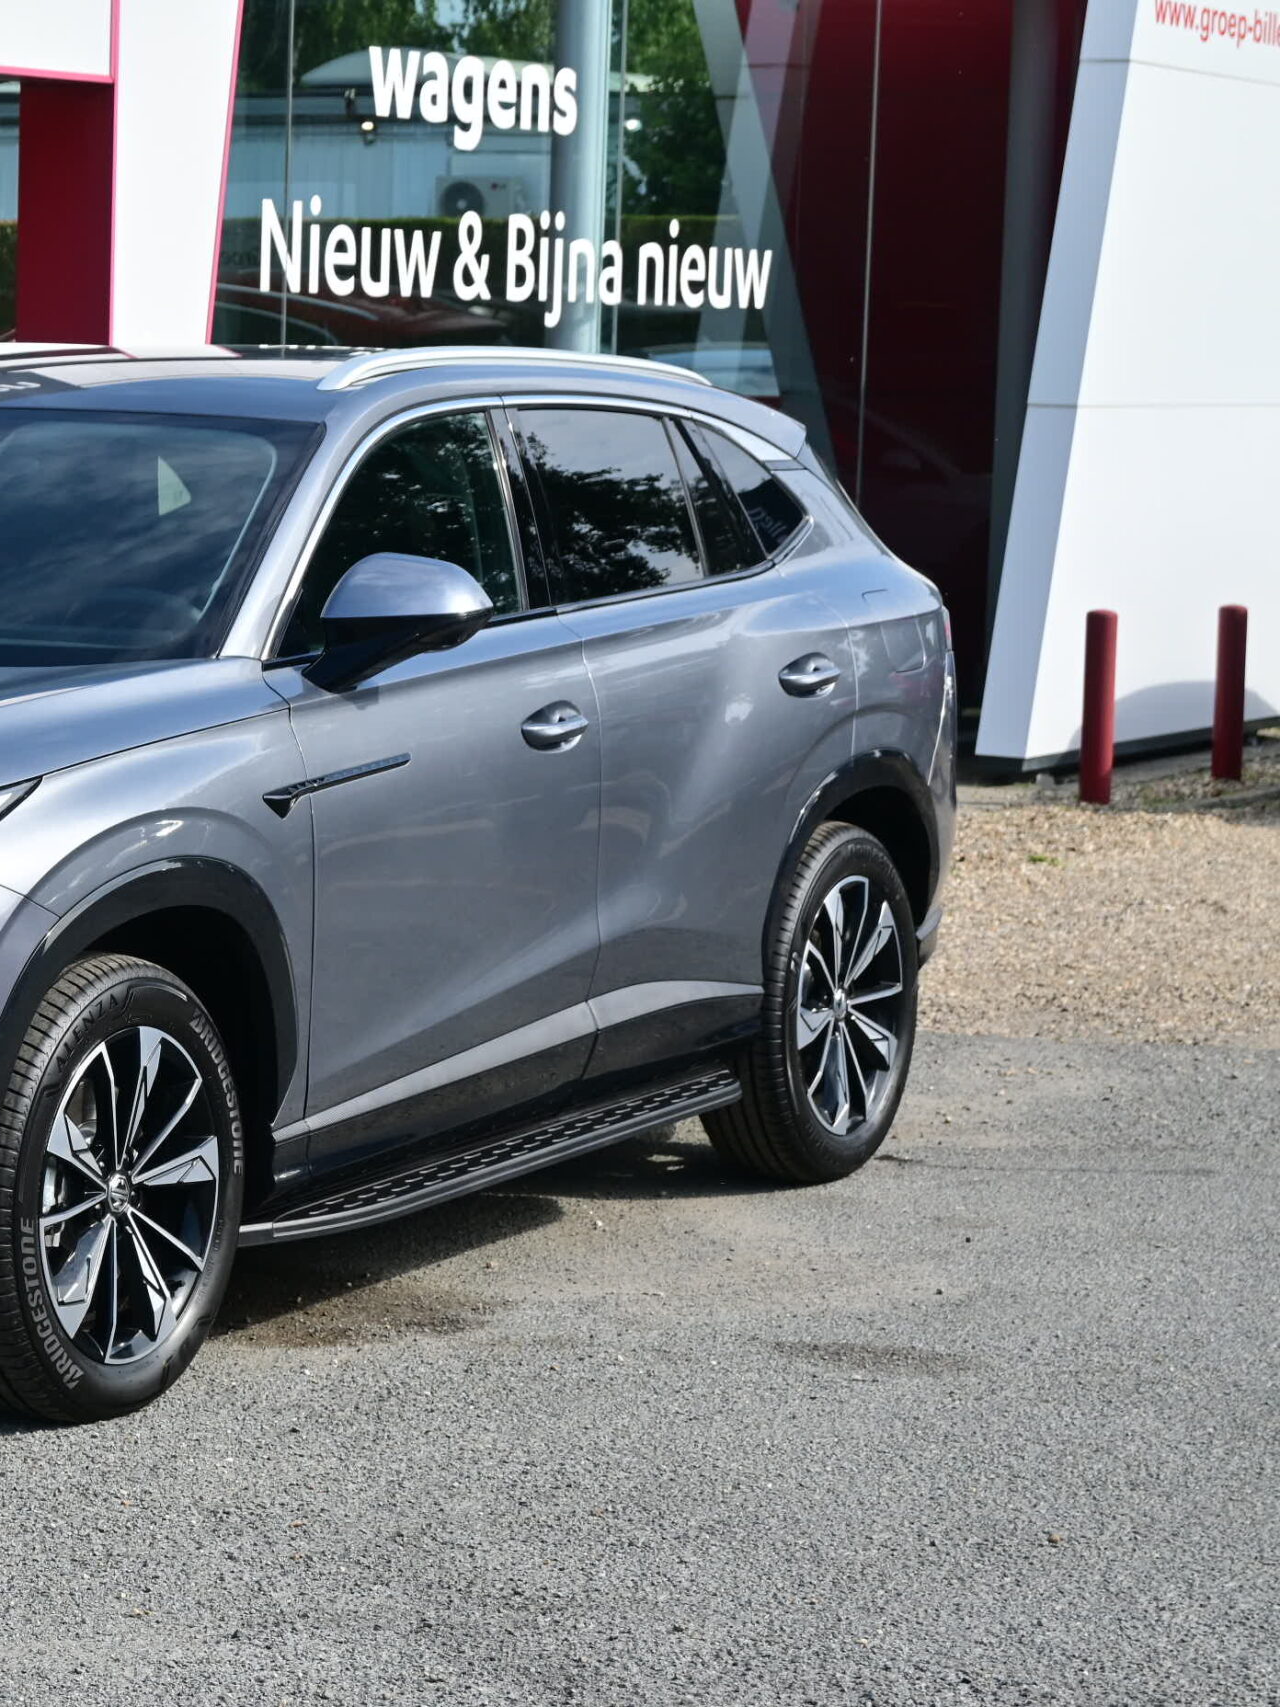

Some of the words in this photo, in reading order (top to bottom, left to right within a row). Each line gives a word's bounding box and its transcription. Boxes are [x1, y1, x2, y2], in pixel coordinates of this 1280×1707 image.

[259, 195, 441, 298] Nieuw
[453, 210, 491, 301] &
[506, 210, 623, 328] Bijna
[637, 219, 773, 310] nieuw
[55, 993, 119, 1074] ALENZA
[188, 1007, 246, 1177] BRIDGESTONE
[20, 1216, 85, 1390] BRIDGESTONE
